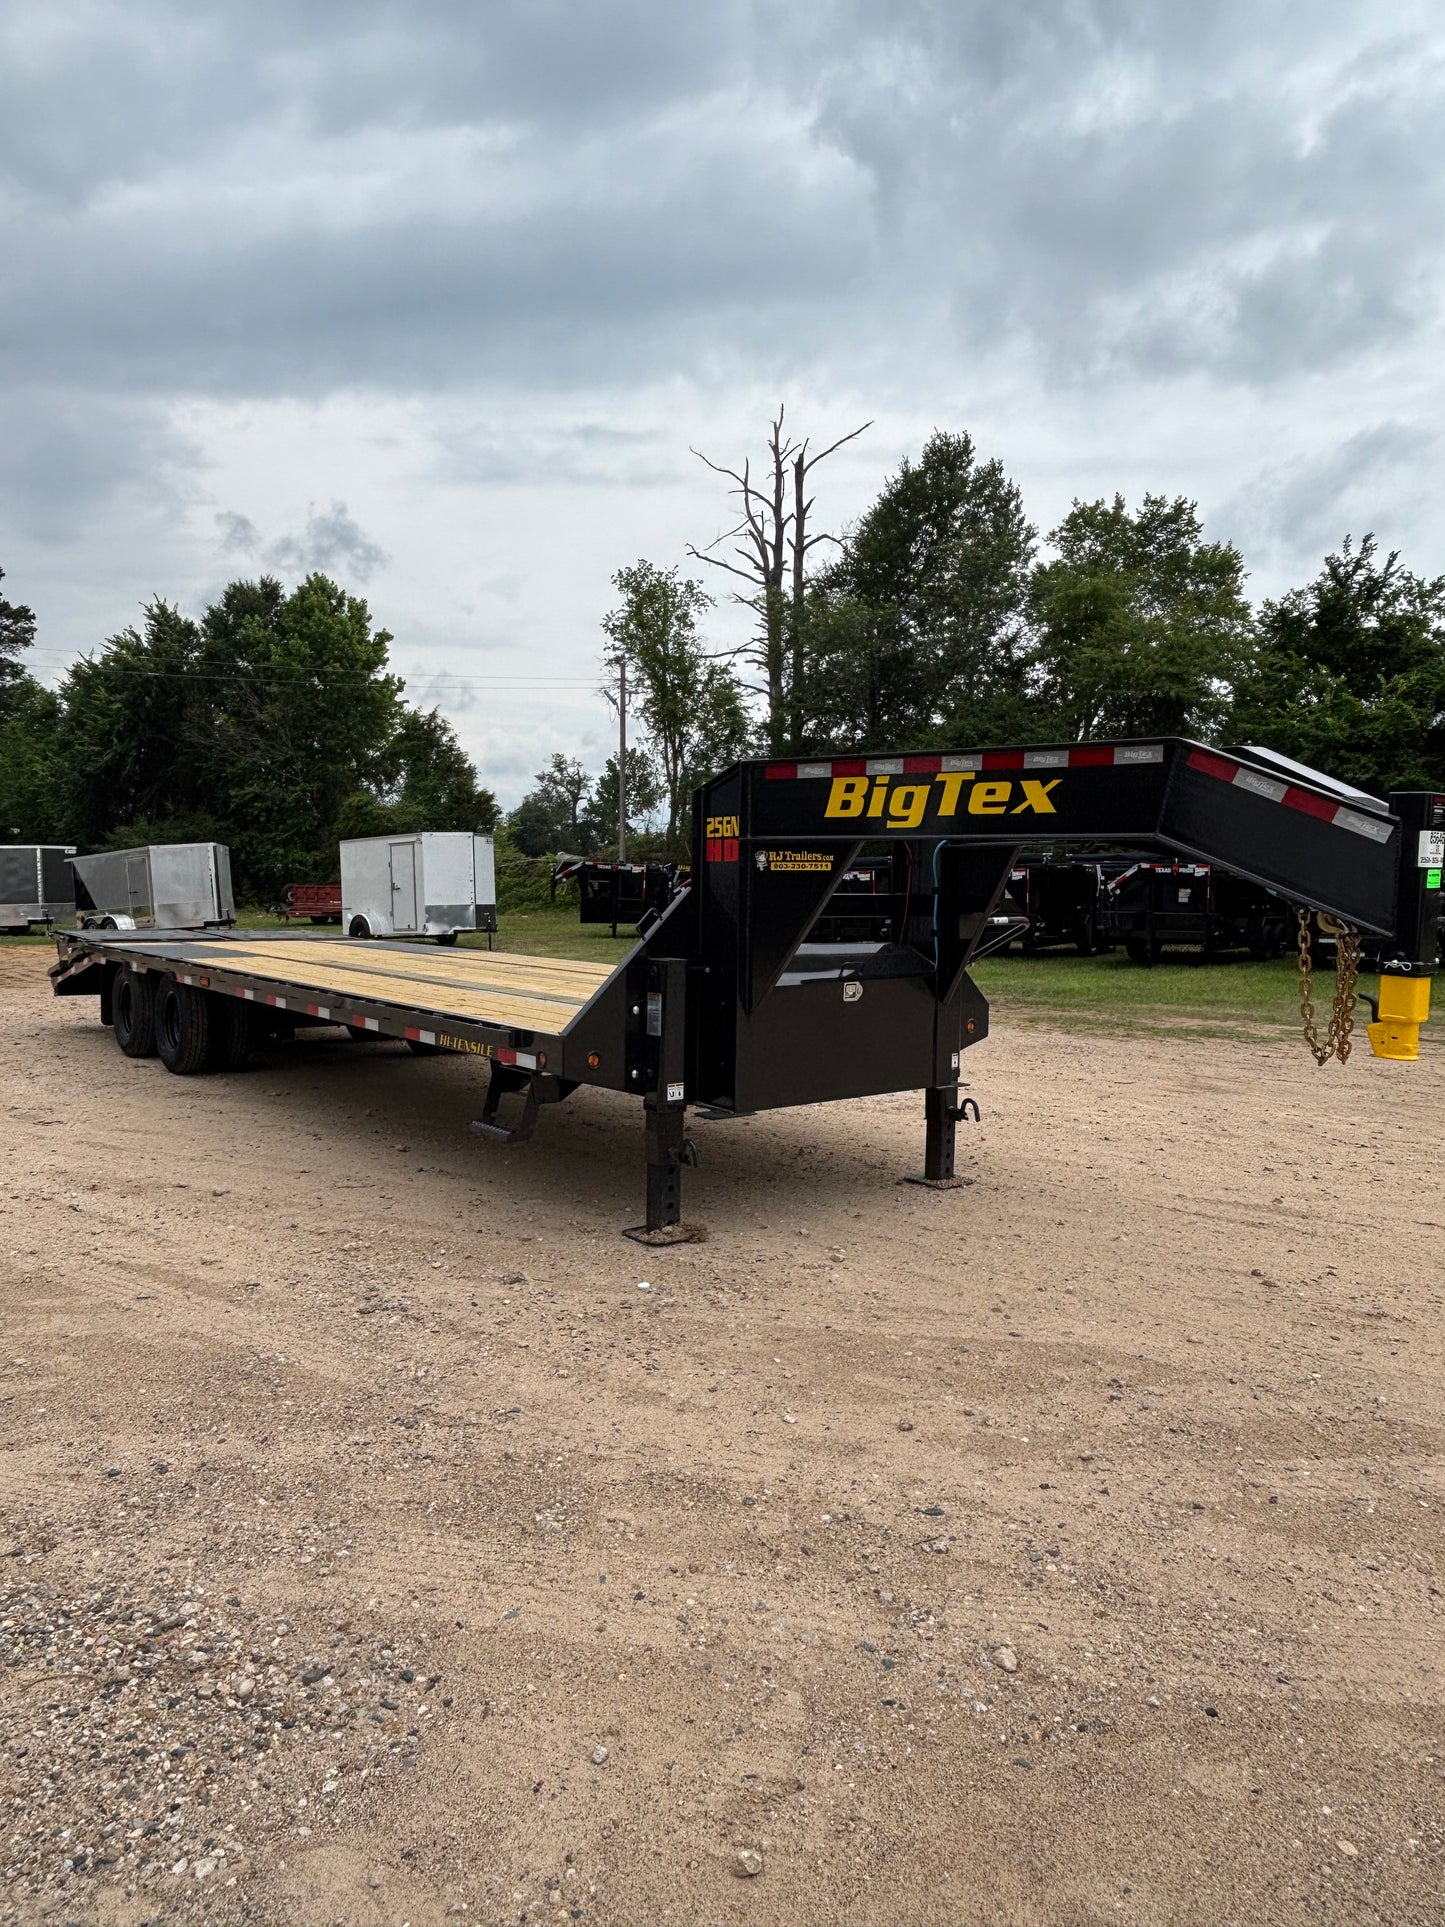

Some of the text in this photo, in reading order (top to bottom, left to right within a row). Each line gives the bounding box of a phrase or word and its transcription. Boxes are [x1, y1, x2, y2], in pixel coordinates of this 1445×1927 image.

[823, 771, 1063, 828] BigTex
[706, 816, 740, 838] 25GN
[706, 838, 739, 862] HD
[768, 851, 784, 862] RJ
[440, 1034, 493, 1057] HI-TENSILE
